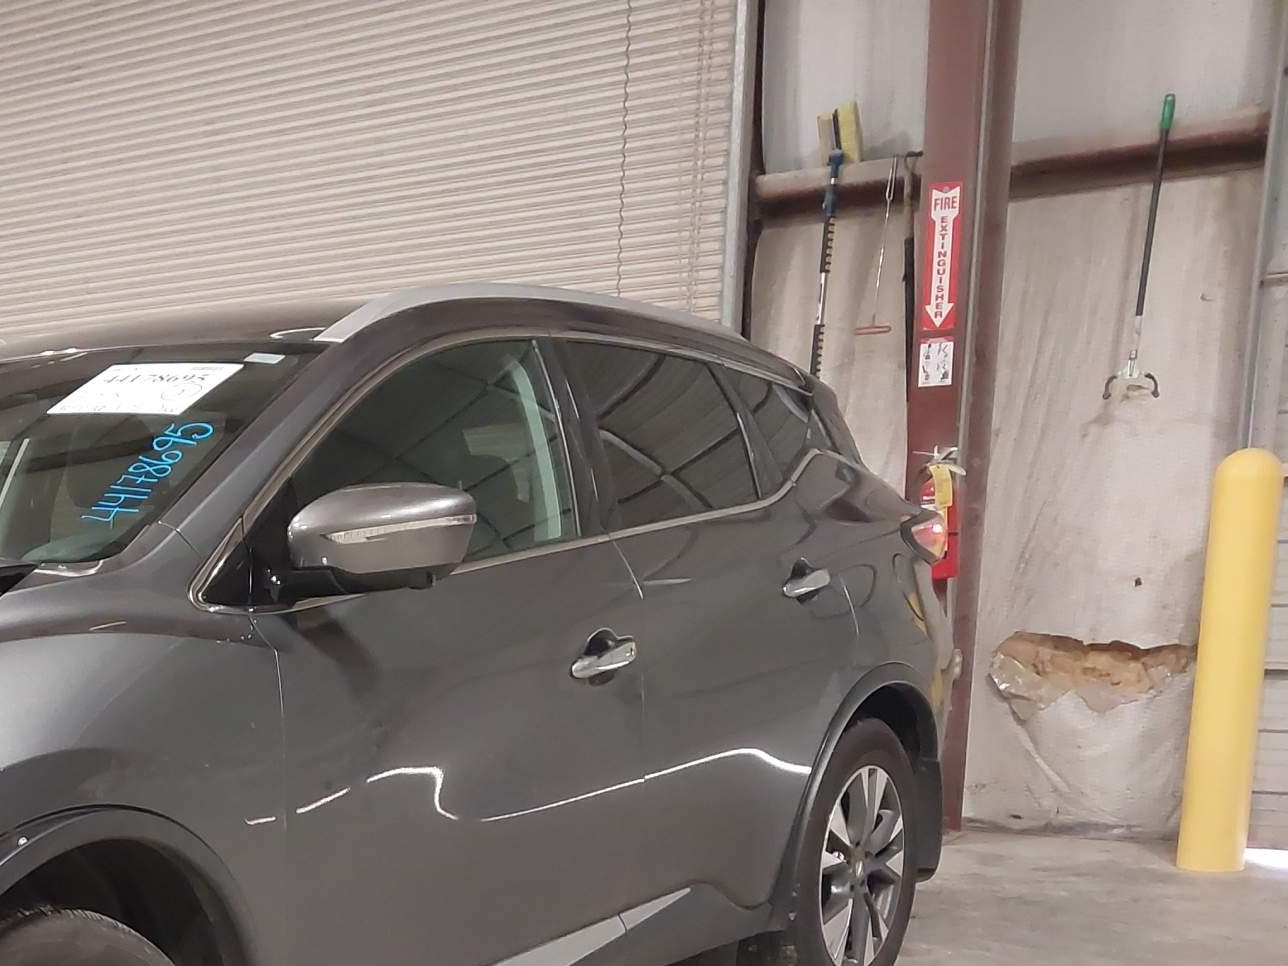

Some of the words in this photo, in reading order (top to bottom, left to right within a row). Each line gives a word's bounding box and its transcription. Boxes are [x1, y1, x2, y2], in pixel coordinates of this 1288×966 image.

[934, 196, 958, 211] FIRE
[934, 215, 949, 319] EXTINGUISHER
[81, 422, 214, 527] 44178695
